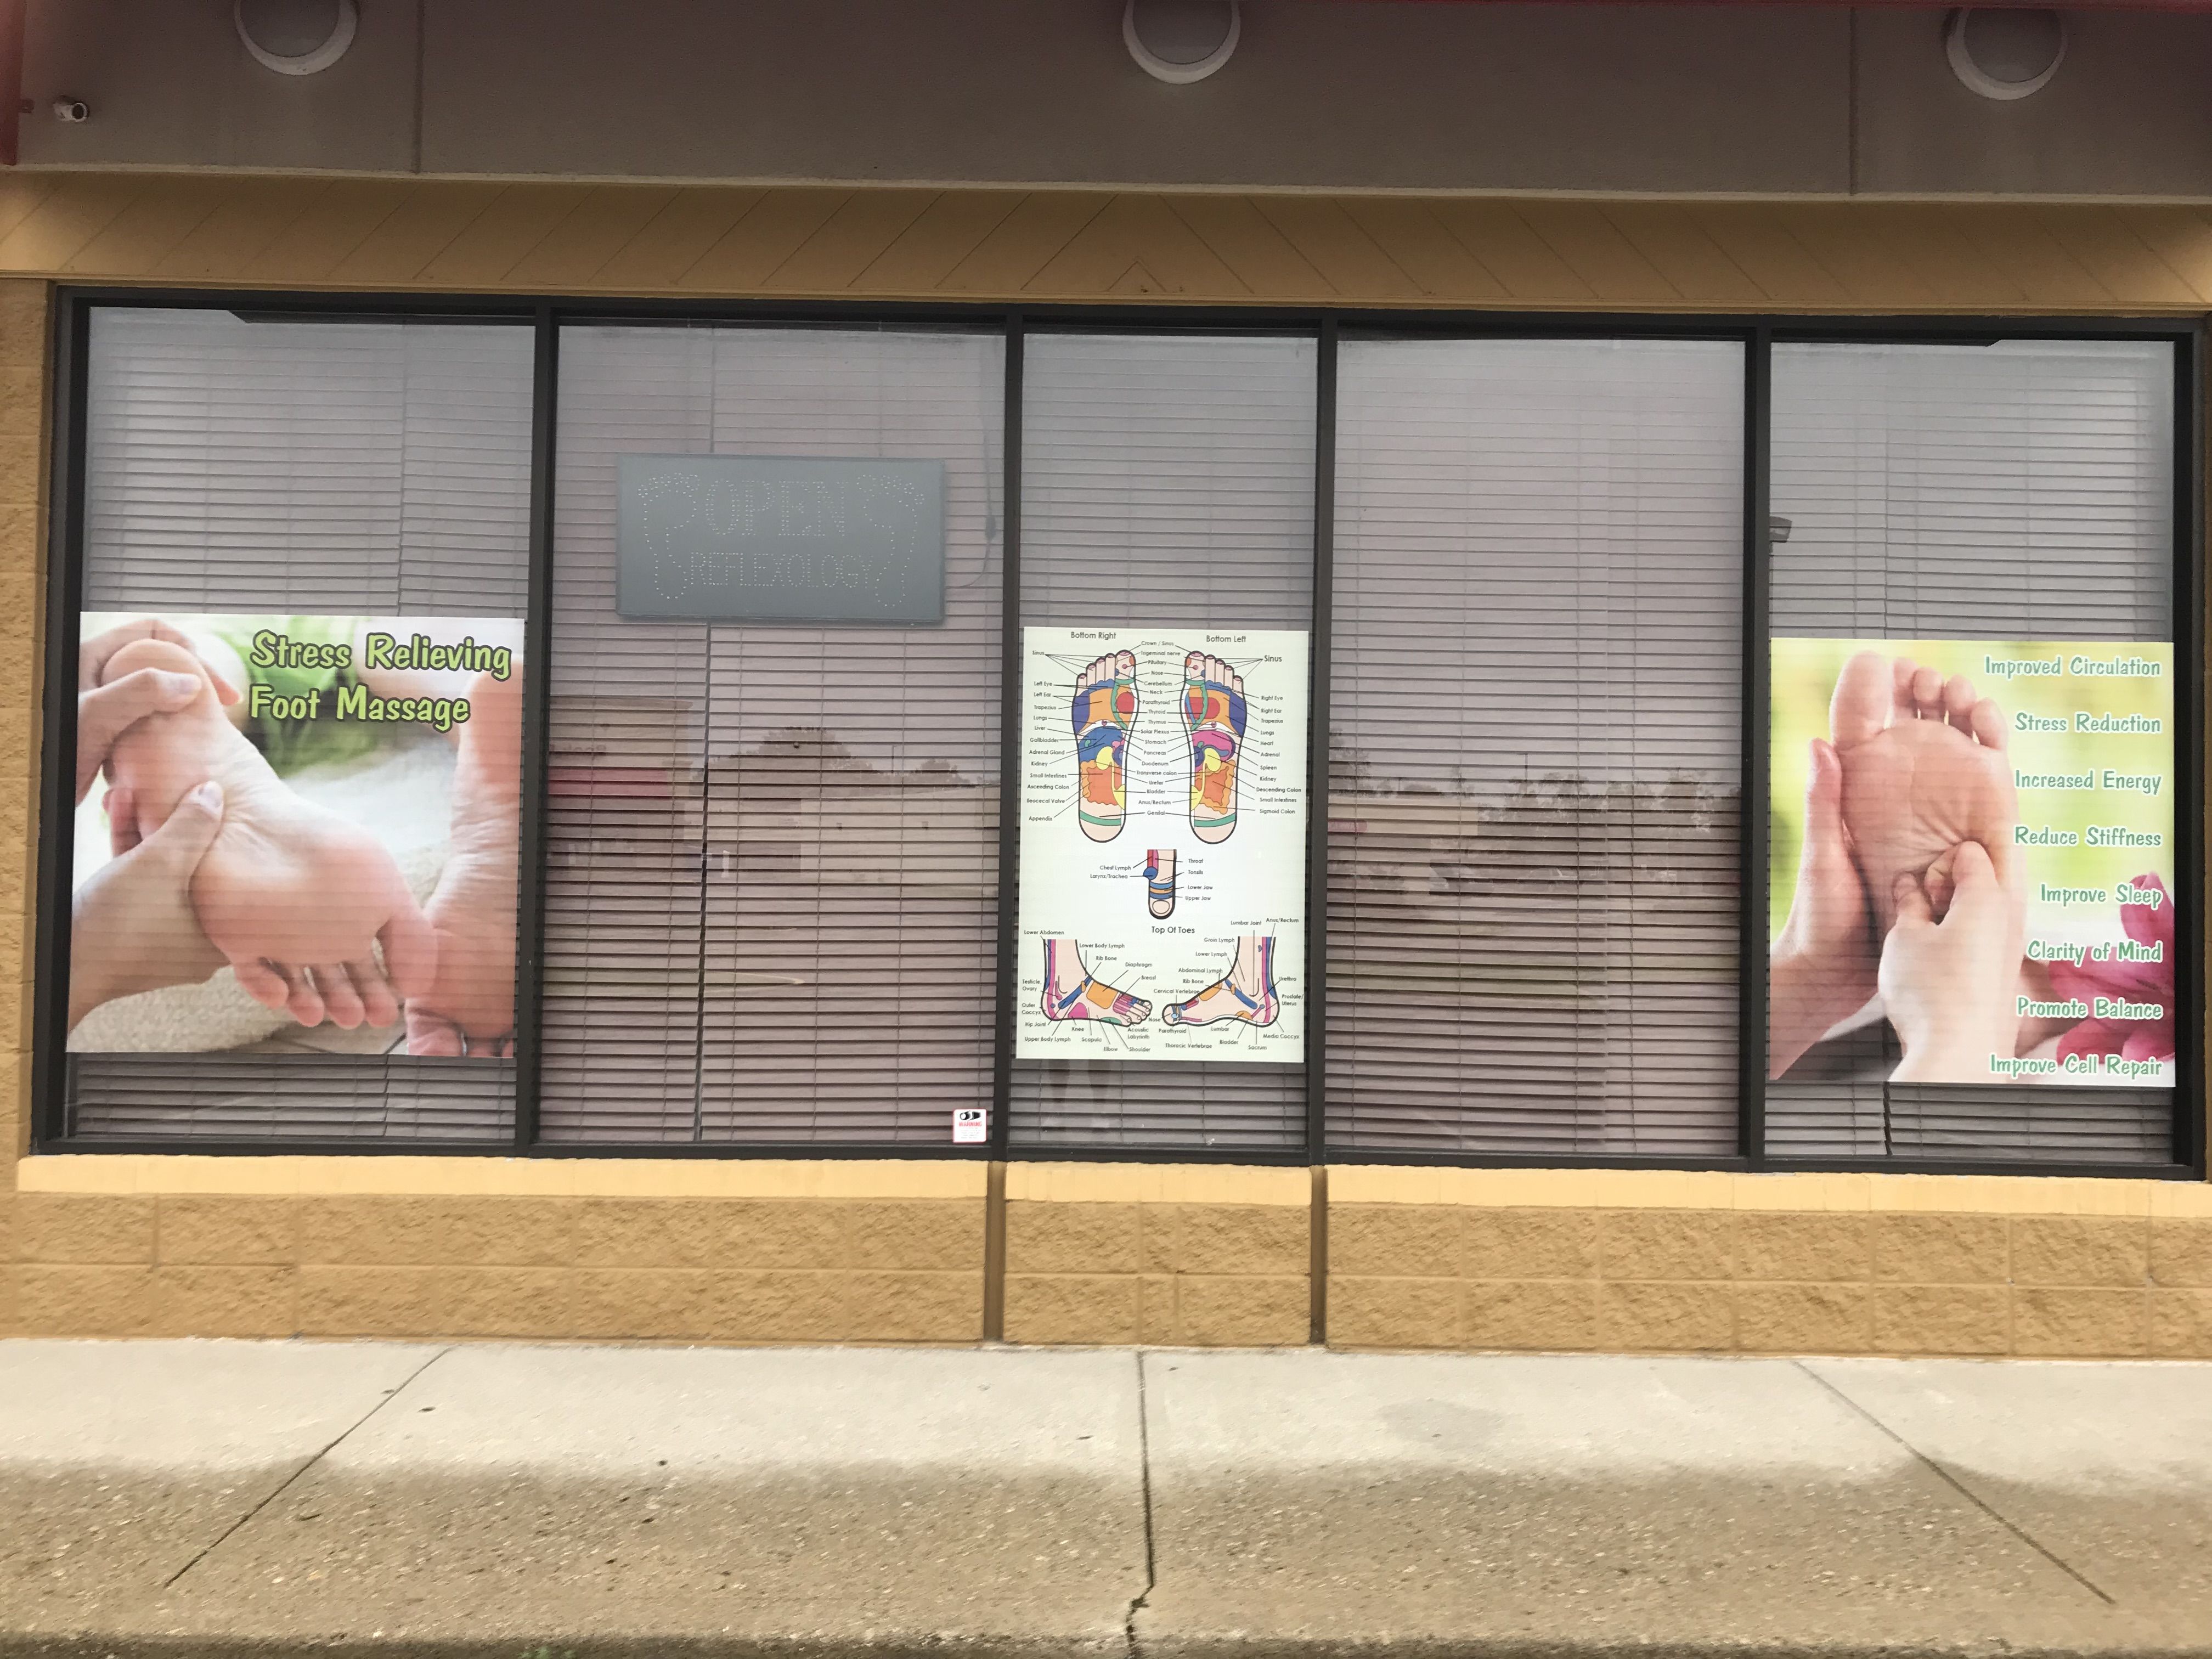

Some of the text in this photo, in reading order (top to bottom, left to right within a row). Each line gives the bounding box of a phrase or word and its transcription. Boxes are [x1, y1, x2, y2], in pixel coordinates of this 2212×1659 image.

[706, 479, 849, 537] OPEN
[691, 552, 874, 588] REFLEXOLOGY
[1098, 632, 1116, 640] Right
[250, 629, 512, 681] Stress Relieving
[1984, 654, 2162, 680] Improved Circulation
[250, 682, 471, 733] Foot Massage
[2014, 711, 2162, 733] Stress Reduction
[2014, 769, 2162, 796] Increased Energy
[2014, 825, 2162, 847] Reduce Stiffness
[2040, 883, 2163, 910] Improve Sleep
[1152, 926, 1165, 934] Top
[2027, 940, 2163, 966] Clarity of Mind
[2017, 996, 2163, 1019] Promote Balance
[1990, 1053, 2164, 1080] Improve Cell Repair
